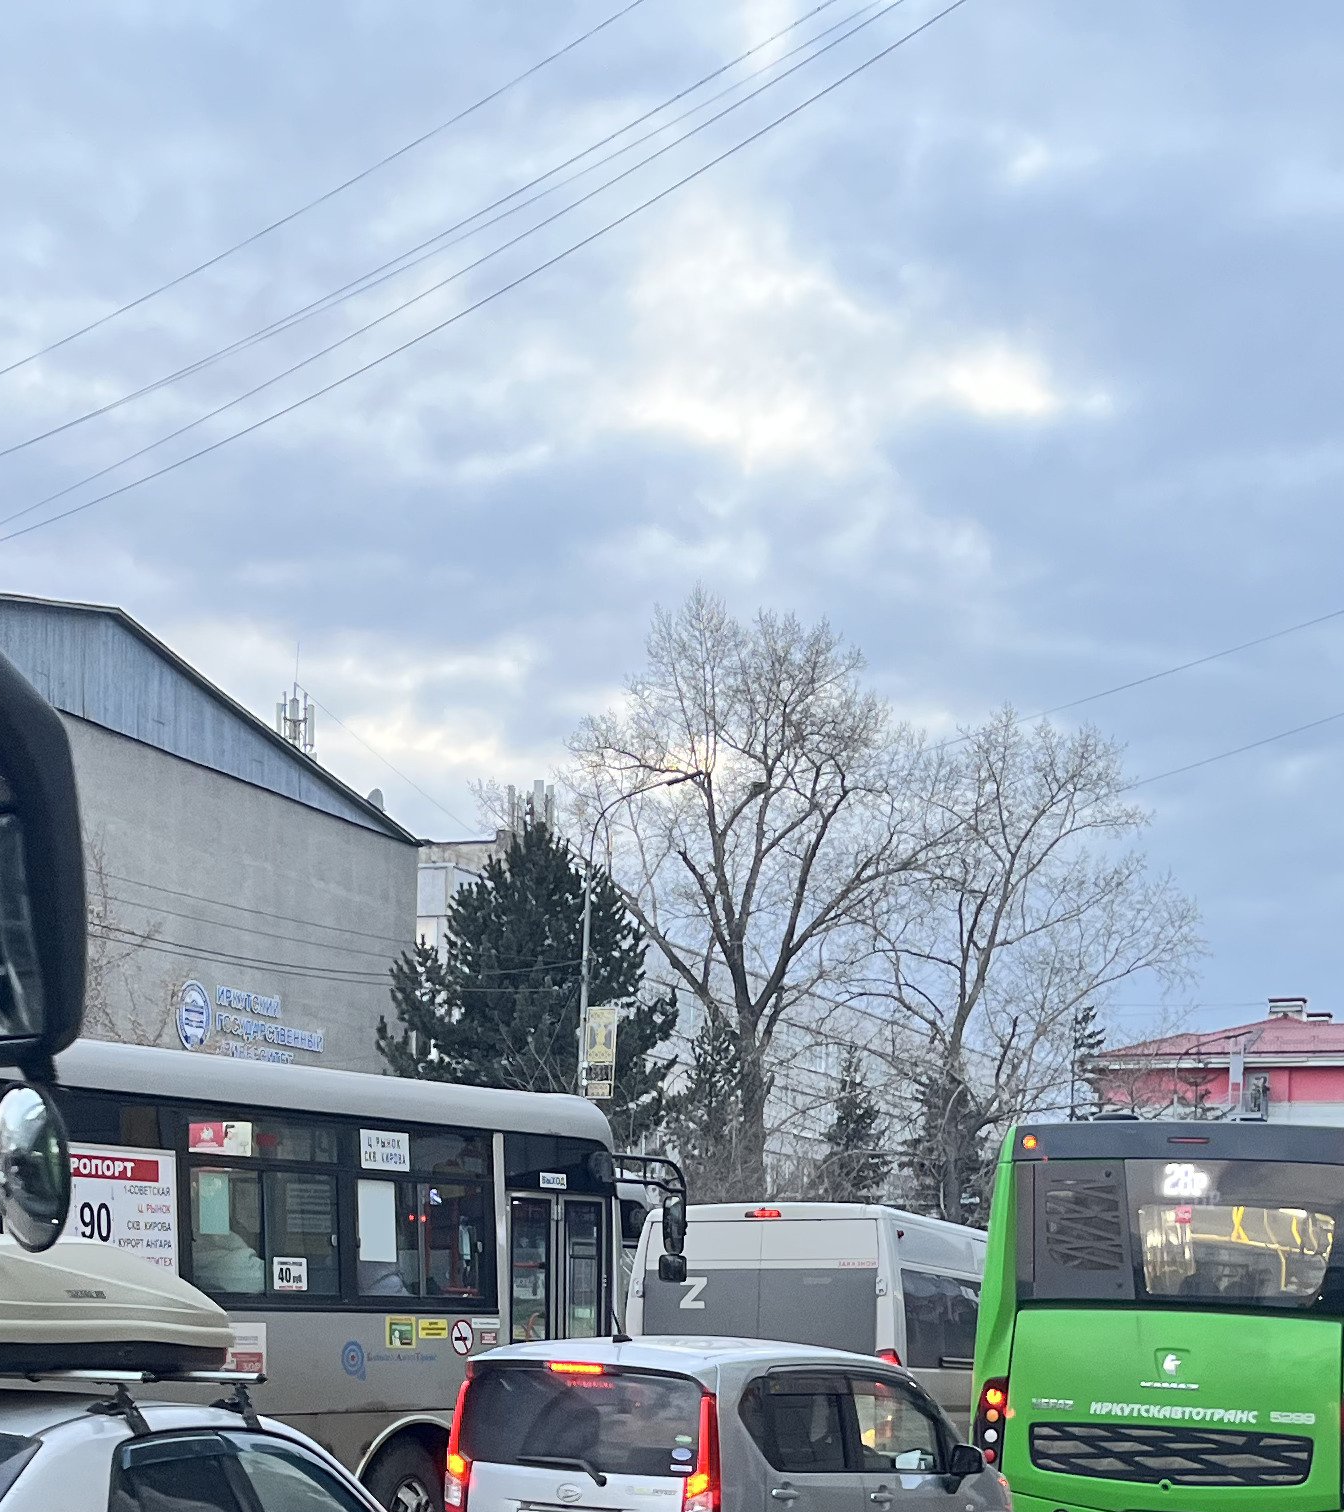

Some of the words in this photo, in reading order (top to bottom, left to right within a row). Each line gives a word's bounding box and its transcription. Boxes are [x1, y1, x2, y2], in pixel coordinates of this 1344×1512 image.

[70, 1157, 135, 1178] РОПОРТ
[79, 1201, 112, 1242] 90
[278, 1267, 292, 1283] 40
[679, 1276, 708, 1309] Z
[1089, 1401, 1259, 1424] ИРКУТСКАВТОТРАНС
